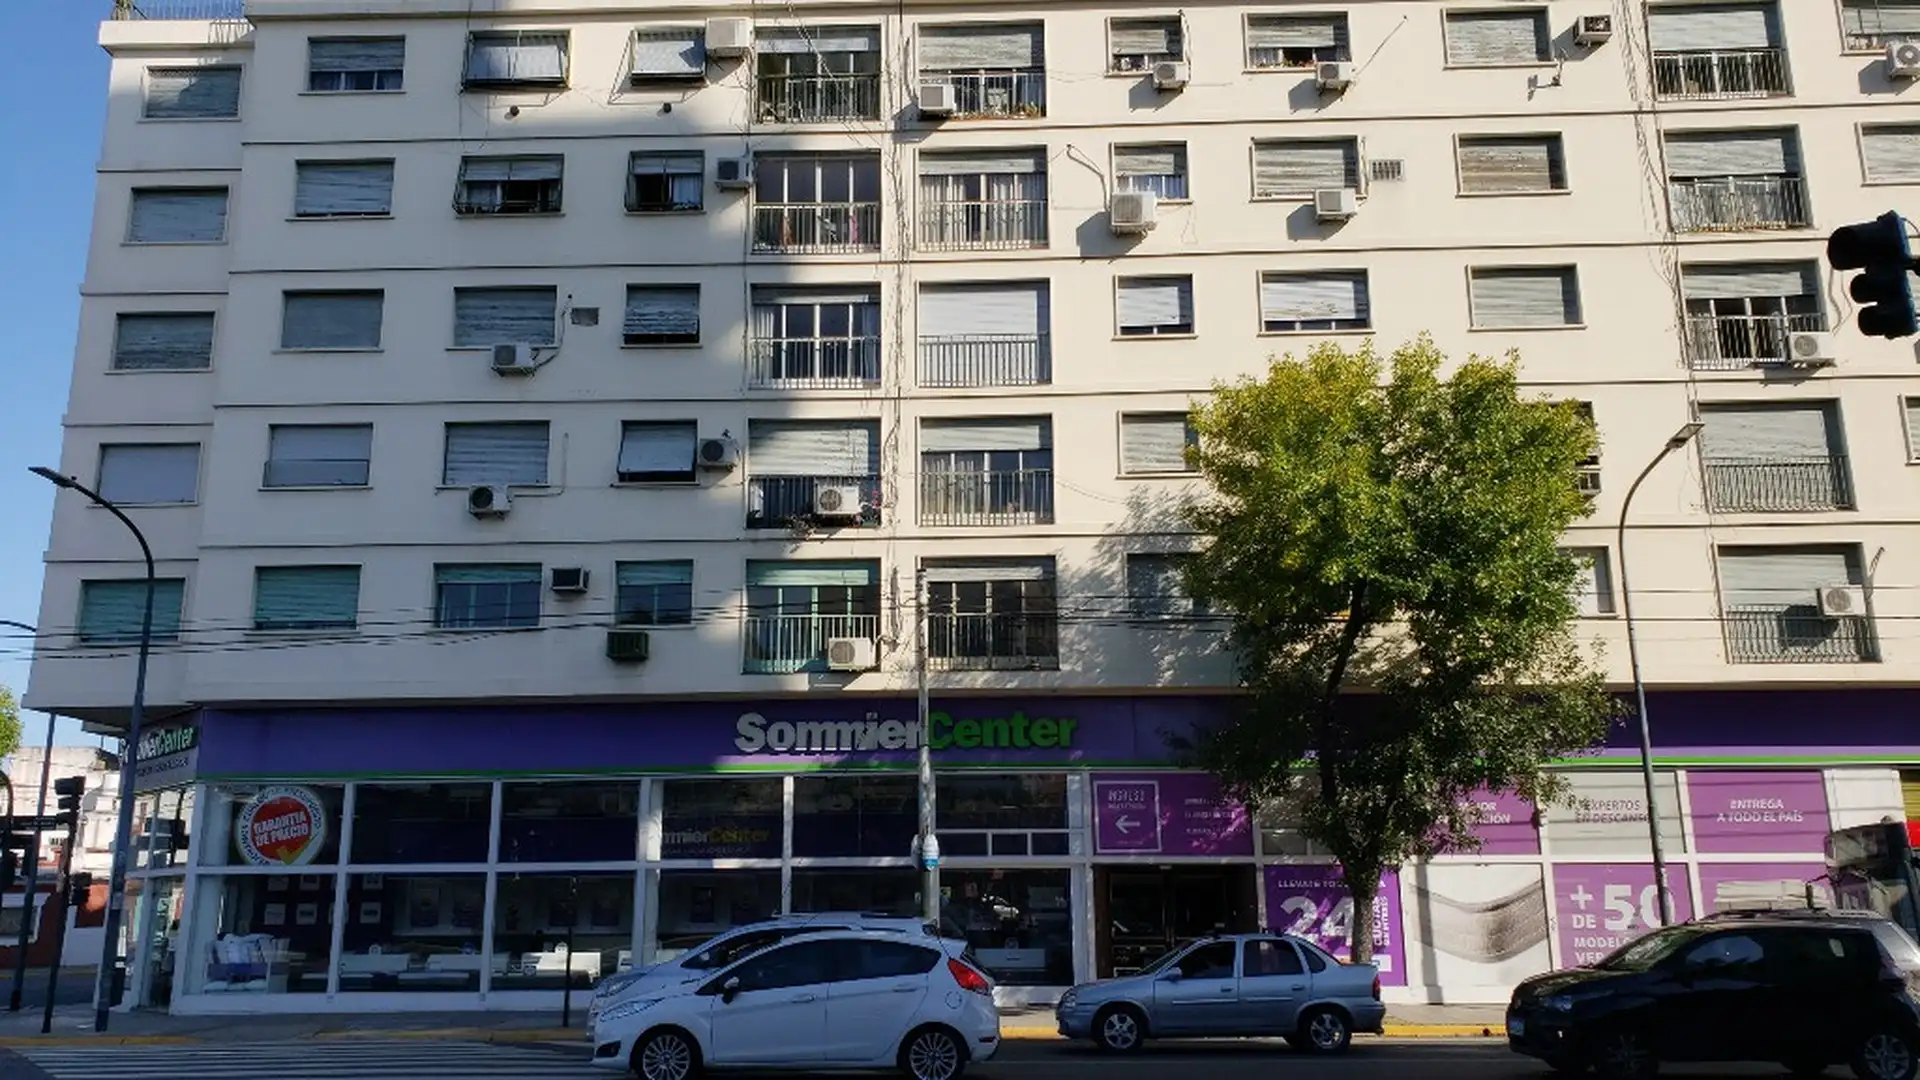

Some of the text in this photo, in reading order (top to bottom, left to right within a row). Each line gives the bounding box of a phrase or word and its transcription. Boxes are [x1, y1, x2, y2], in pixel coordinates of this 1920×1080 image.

[1730, 799, 1784, 809] ENTREGA
[1728, 812, 1761, 822] TODO
[1280, 896, 1354, 946] 24
[1571, 914, 1597, 929] DE
